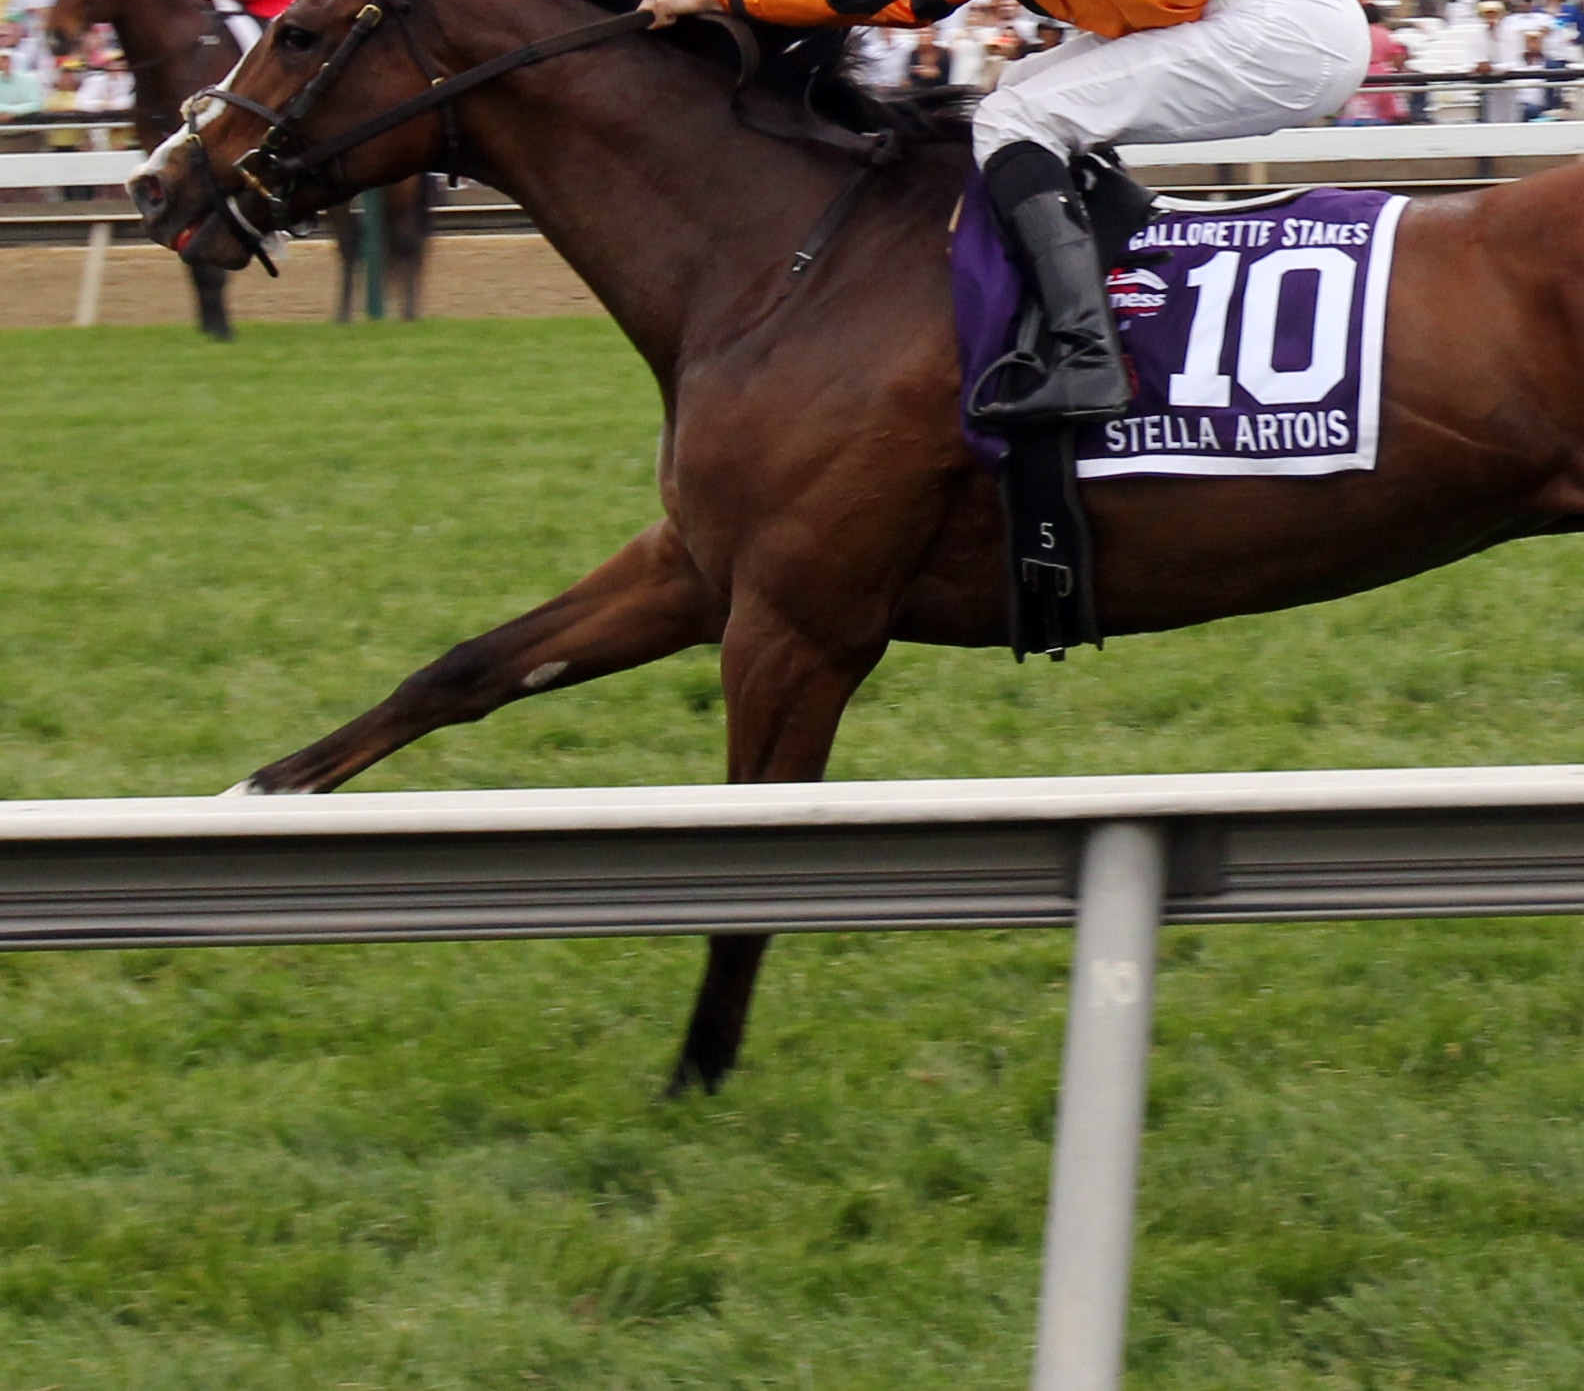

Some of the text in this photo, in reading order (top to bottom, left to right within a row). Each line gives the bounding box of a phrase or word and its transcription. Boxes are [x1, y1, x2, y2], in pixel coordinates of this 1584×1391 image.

[1129, 218, 1370, 251] GALLORETTE STAKES
[1108, 292, 1167, 309] ness
[1168, 247, 1358, 408] 10
[1104, 409, 1350, 452] STELLA ARTOIS
[1040, 522, 1055, 549] 5
